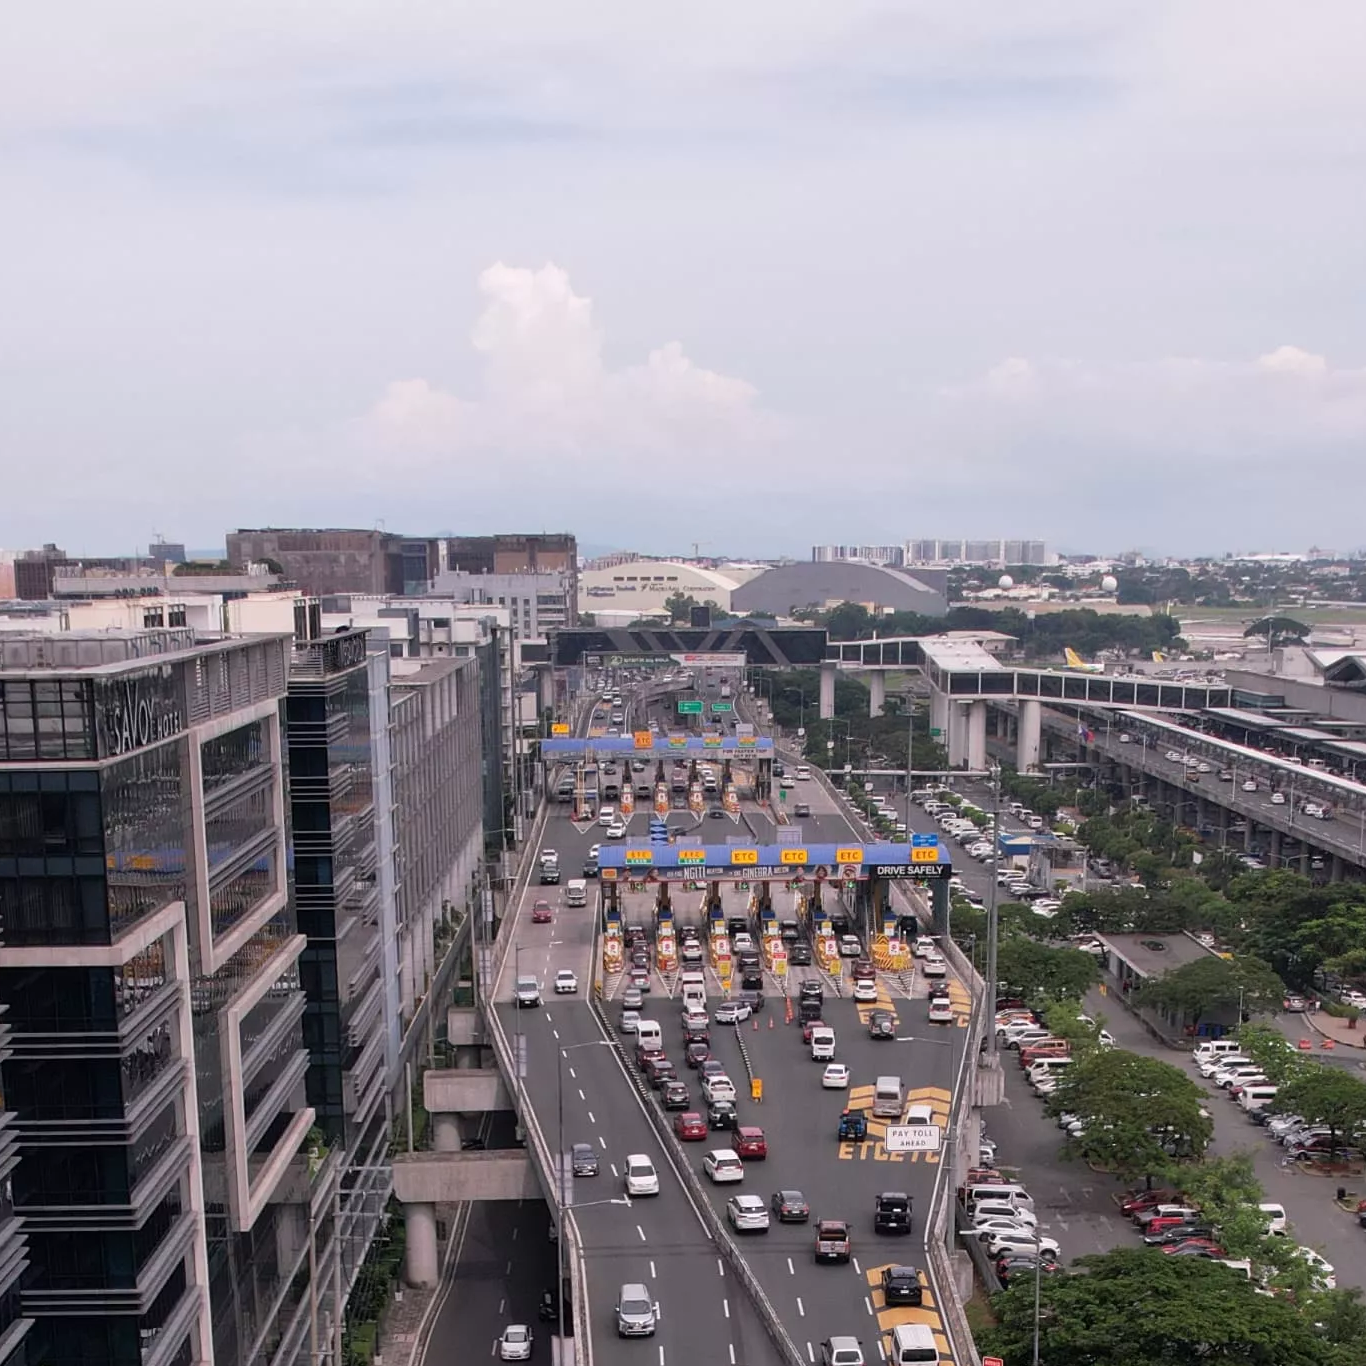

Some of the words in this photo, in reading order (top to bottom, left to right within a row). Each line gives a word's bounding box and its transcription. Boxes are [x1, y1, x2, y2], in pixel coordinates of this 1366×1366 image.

[115, 681, 154, 754] SAVOY
[157, 710, 183, 741] HOTEL
[735, 853, 754, 861] ETC
[785, 852, 803, 860] ETC
[840, 852, 859, 860] ETC
[915, 850, 934, 859] ETC
[743, 866, 773, 879] GINEBRA
[877, 866, 905, 874] DRIVE
[907, 865, 943, 874] SAFELY
[839, 1141, 888, 1160] ETC
